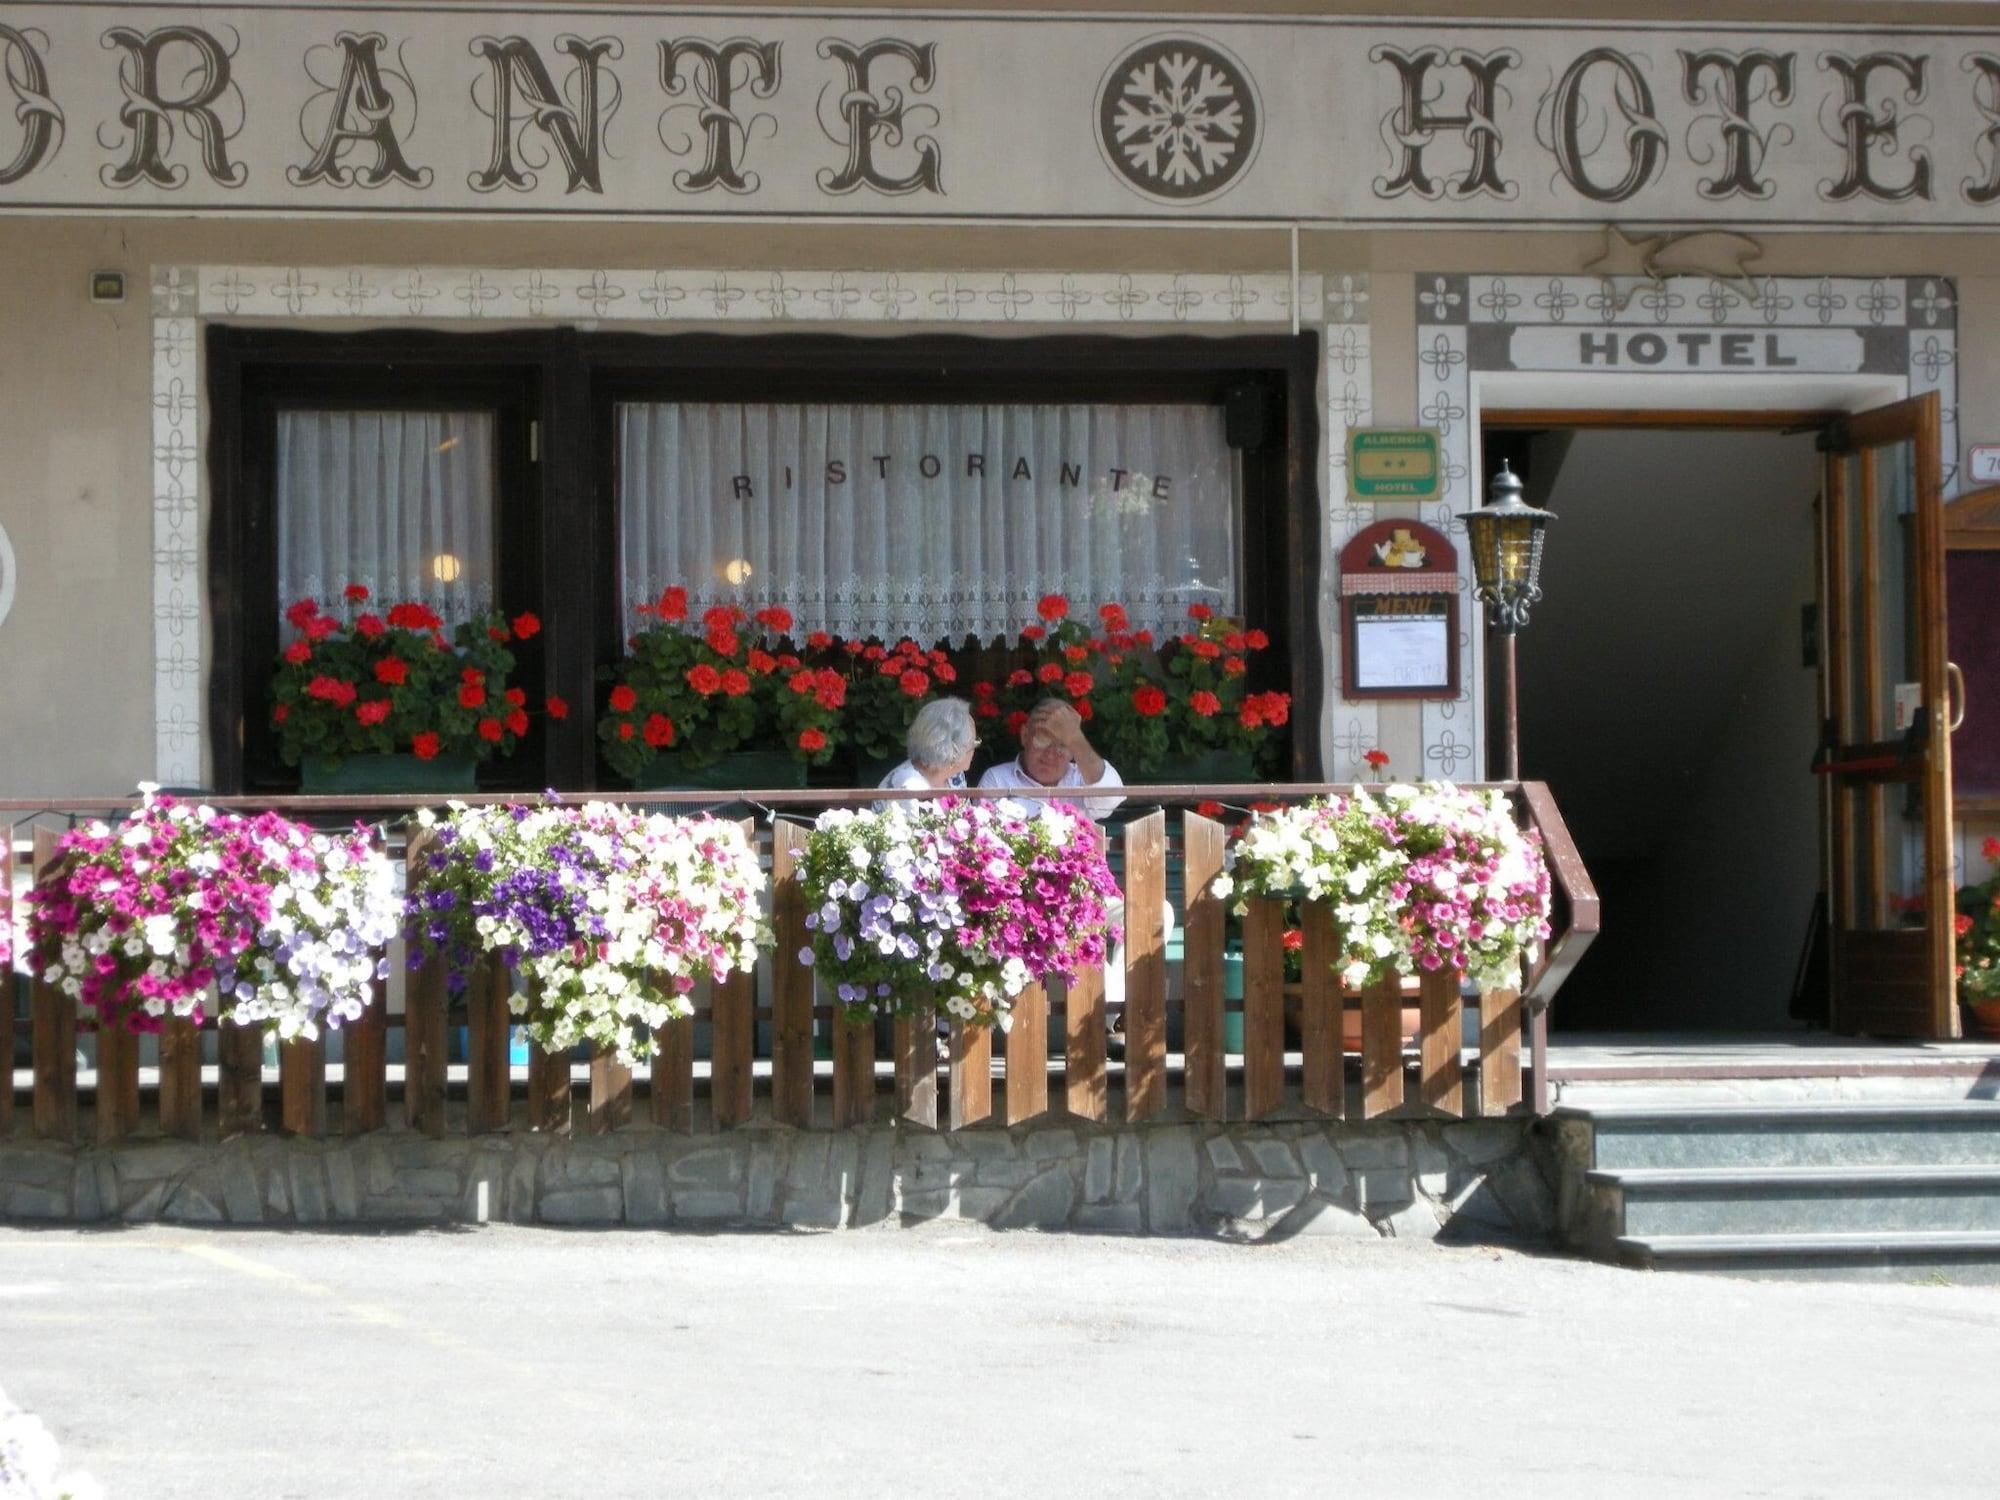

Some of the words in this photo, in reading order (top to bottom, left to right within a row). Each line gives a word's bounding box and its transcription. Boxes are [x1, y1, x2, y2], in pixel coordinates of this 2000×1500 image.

[1579, 331, 1797, 367] HOTEL
[732, 453, 1172, 501] RISTORANTE
[1374, 482, 1418, 493] HOTEL
[1374, 596, 1432, 615] MENU
